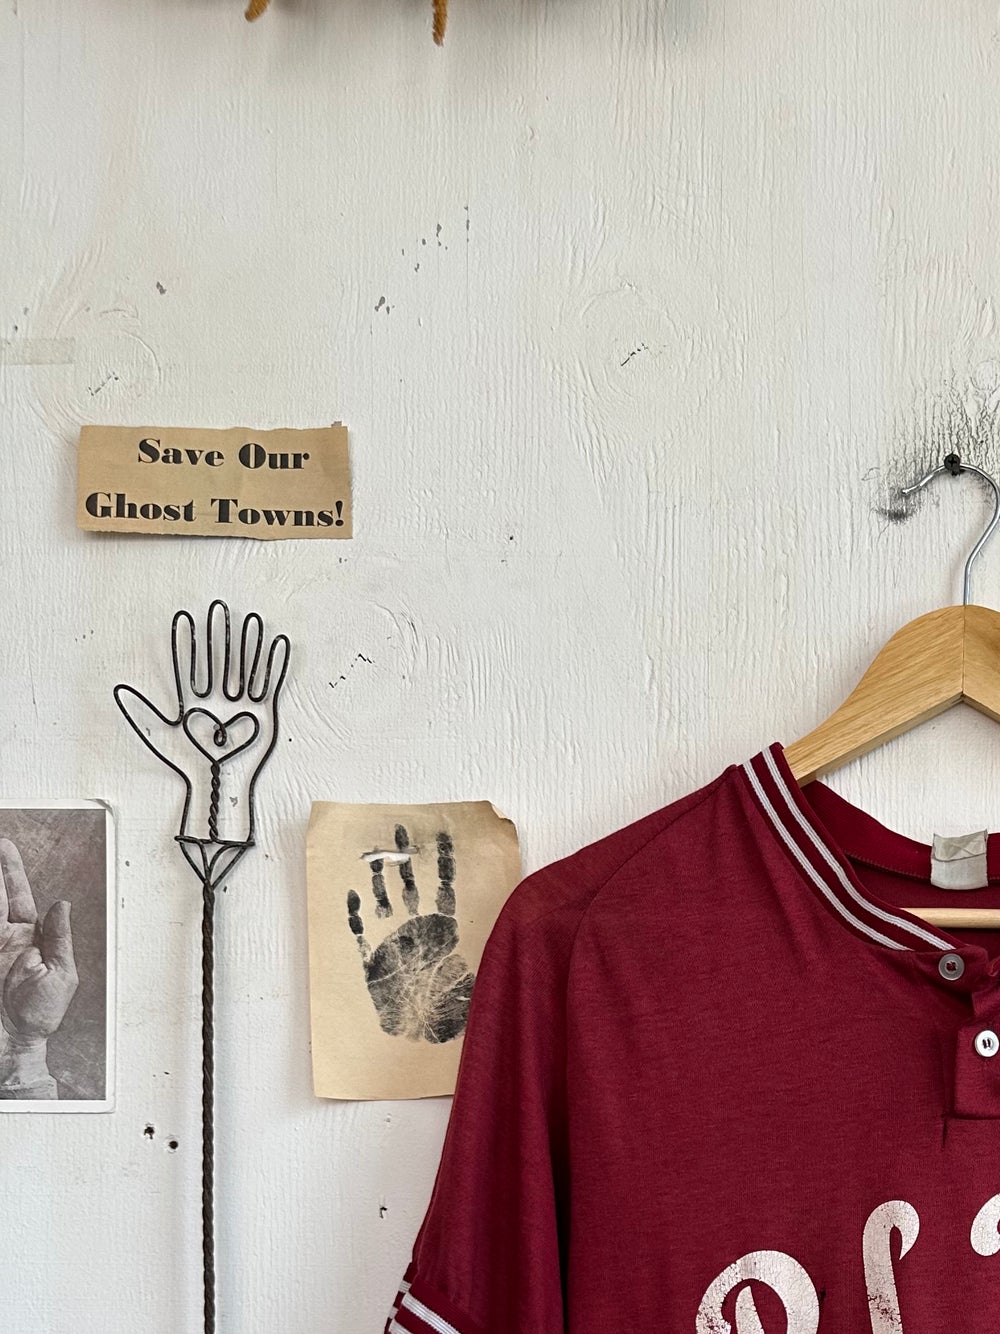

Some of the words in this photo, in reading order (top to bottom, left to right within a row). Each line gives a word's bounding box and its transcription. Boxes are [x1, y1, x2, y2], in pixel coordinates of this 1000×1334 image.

[138, 438, 225, 467] Save
[238, 443, 310, 470] Our
[85, 492, 197, 522] Ghost
[210, 498, 345, 527] Towns!
